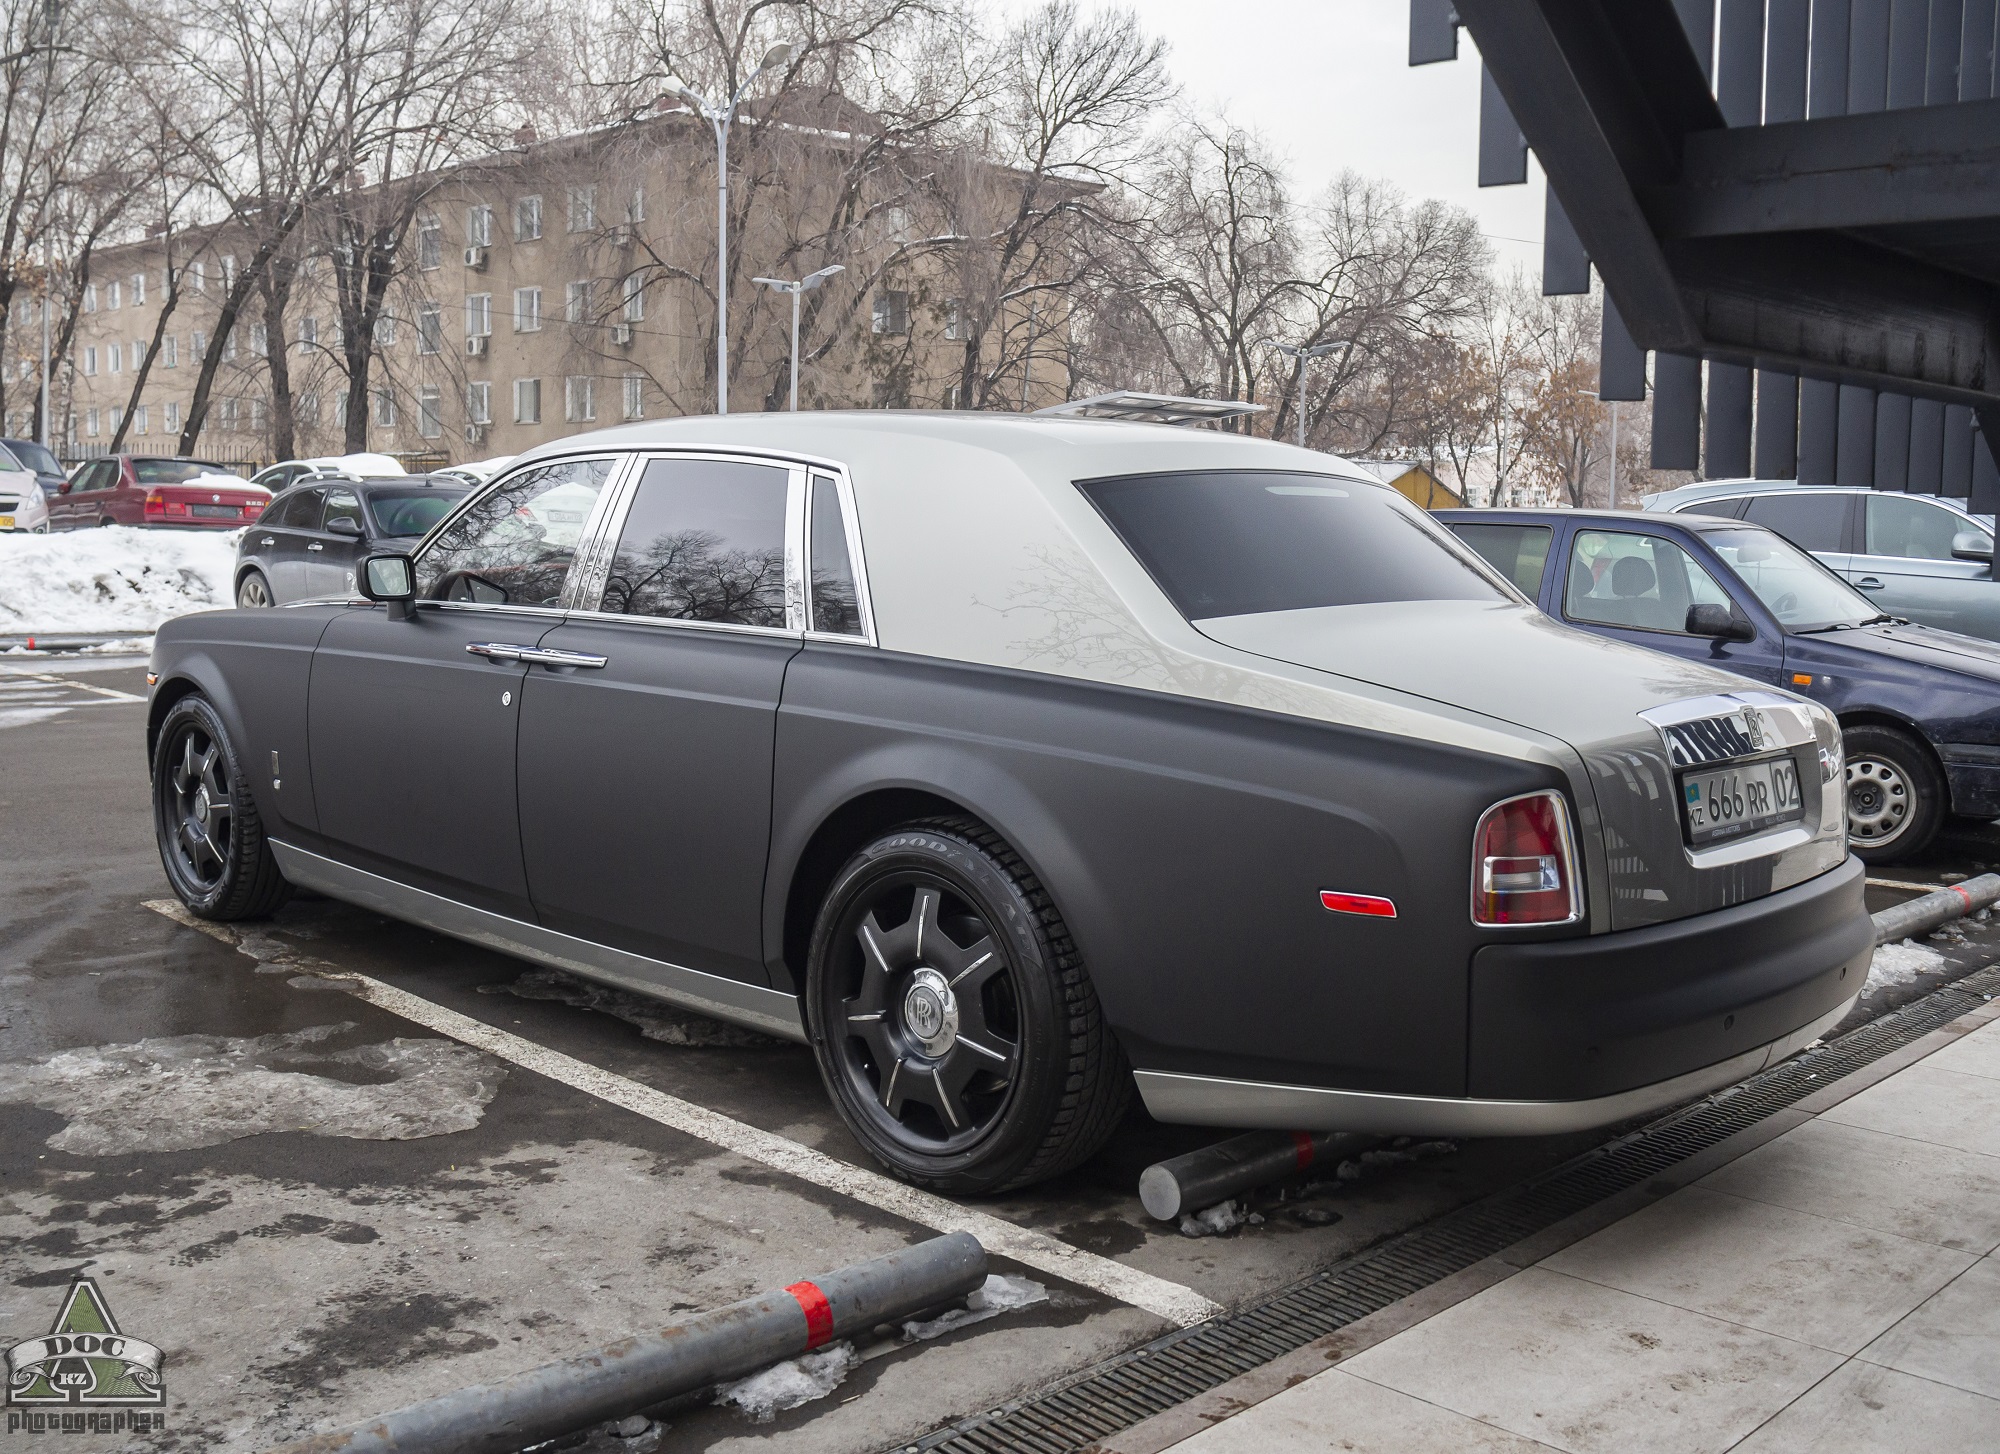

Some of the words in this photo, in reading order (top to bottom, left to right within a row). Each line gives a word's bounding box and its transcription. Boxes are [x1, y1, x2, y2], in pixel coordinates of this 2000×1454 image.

[1708, 775, 1745, 822] 666
[1746, 781, 1770, 815] RR
[1774, 766, 1798, 807] 02
[1688, 806, 1705, 827] KZ
